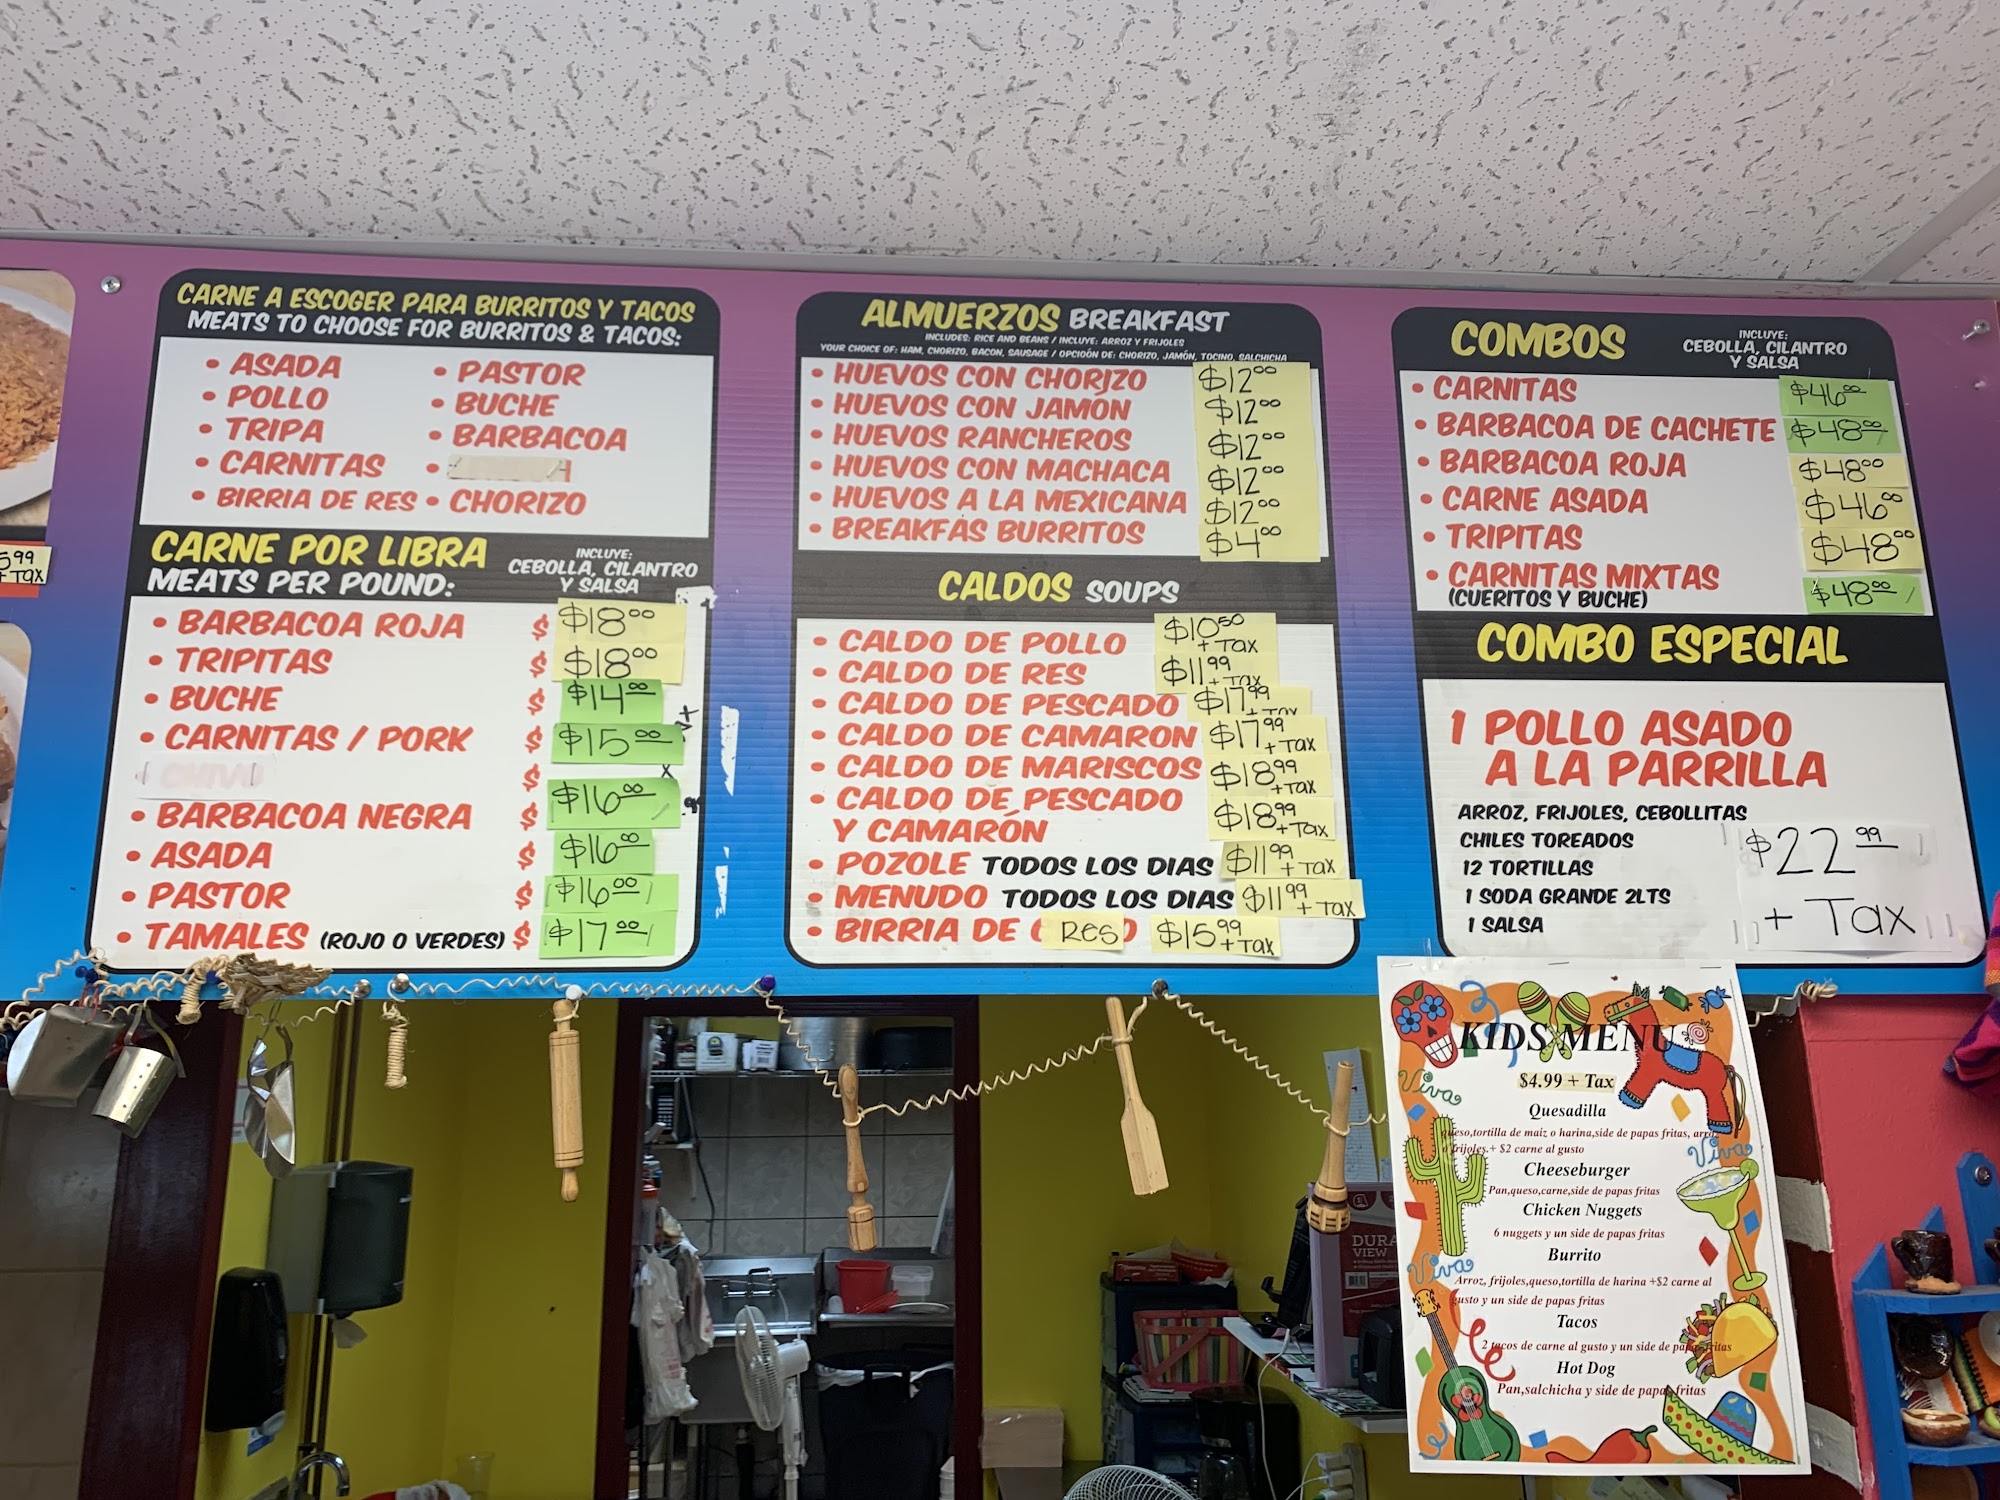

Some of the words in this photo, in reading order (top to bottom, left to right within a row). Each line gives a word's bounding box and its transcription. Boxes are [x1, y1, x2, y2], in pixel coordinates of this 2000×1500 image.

[177, 282, 260, 307] CARNE
[264, 287, 281, 308] A
[289, 287, 394, 312] ESCOGER
[402, 293, 466, 315] PARA
[475, 294, 591, 320] BURRITOS
[599, 299, 613, 319] Y
[621, 300, 696, 322] TACOS
[187, 310, 271, 332] MEATS
[276, 313, 307, 333] TO
[313, 314, 402, 337] CHOOSE
[407, 319, 453, 338] FOR
[459, 320, 572, 343] BURRITOS
[578, 325, 594, 342] &
[604, 325, 681, 346] TACOS:
[861, 299, 1061, 332] ALMUERZOS
[1069, 308, 1230, 333] BREAKFAST
[820, 344, 846, 352] YOUR
[848, 344, 881, 353] CHOICE
[883, 346, 898, 354] OF:
[901, 346, 924, 355] HAM,
[927, 347, 968, 357] CHORIZO,
[972, 348, 1005, 357] BACON,
[1008, 349, 1049, 357] SAUSAGE
[1101, 351, 1116, 359] DE:
[1118, 351, 1159, 361] CHORIZO,
[1163, 350, 1197, 362] JAMÓN,
[1238, 353, 1287, 362] SALCHICHA
[925, 333, 971, 342] INCLUDES:
[974, 334, 995, 343] RICE
[997, 335, 1017, 343] AND
[1019, 335, 1049, 344] BEANS
[1059, 336, 1098, 346] INCLUYE:
[1101, 337, 1132, 345] ARROZ
[1135, 338, 1141, 346] Y
[1143, 338, 1185, 347] FRIJOLES
[1451, 320, 1626, 360] COMBOS
[230, 352, 341, 378] ASADA
[458, 360, 585, 386] PASTOR
[833, 362, 949, 387] HUEVOS
[956, 365, 1017, 388] CON
[1025, 367, 1147, 392] CHORIZO
[227, 385, 328, 410] POLLO
[455, 392, 559, 416] BUCHE
[226, 417, 324, 442] TRIPA
[452, 423, 627, 451] BARBACOA
[833, 423, 949, 448] HUEVOS
[957, 426, 1132, 451] RANCHEROS
[1437, 411, 1594, 439] BARBACOA
[1604, 415, 1642, 440] DE
[1650, 416, 1777, 442] CACHETE
[220, 450, 386, 478] CARNITAS
[217, 487, 310, 509] BIRRIA
[320, 490, 356, 509] DE
[365, 490, 417, 511] RES
[449, 489, 586, 515] CHORIZO
[832, 485, 949, 510] HUEVOS
[957, 488, 977, 511] A
[989, 488, 1024, 511] LA
[1034, 489, 1187, 514] MEXICANA
[832, 516, 988, 542] BREAKFAS
[997, 520, 1145, 545] BURRITOS
[151, 530, 280, 563] CARNE
[289, 534, 369, 566] POR
[377, 534, 488, 568] LIBRA
[576, 548, 632, 560] INCLUYE:
[508, 558, 597, 577] CEBOLLA,
[604, 561, 698, 578] CILANTRO
[1449, 561, 1598, 588] CARNITAS
[1606, 563, 1720, 590] MIXTAS
[147, 568, 258, 593] MEATS
[268, 571, 330, 594] PER
[339, 573, 456, 597] POUND:
[561, 579, 574, 592] Y
[578, 577, 639, 594] SALSA
[938, 570, 1073, 602] CALDOS
[1085, 580, 1180, 604] SOUPS
[1449, 589, 1552, 608] (CUERITOS
[1560, 591, 1572, 607] Y
[1578, 590, 1648, 609] BUCHE)
[838, 629, 953, 653] CALDO
[965, 631, 1011, 653] DE
[1021, 632, 1127, 655] POLLO
[1476, 621, 1635, 664] COMBO
[1650, 624, 1848, 665] ESPECIAL
[176, 647, 332, 674] TRIPITAS
[377, 726, 474, 752] PORK
[1451, 710, 1467, 745] 1
[1485, 709, 1624, 746] POLLO
[1640, 710, 1792, 747] ASADO
[1608, 750, 1828, 788] PARRILLA
[156, 802, 347, 829] BARBACOA
[358, 803, 472, 830] NEGRA
[833, 818, 858, 843] Y
[867, 809, 1049, 843] CAMARÓN
[1458, 804, 1528, 822] ARROZ,
[1536, 805, 1628, 823] FRIJOLES,
[1635, 805, 1748, 821] CEBOLLITAS
[1460, 832, 1525, 848] CHILES
[1531, 832, 1634, 849] TOREADOS
[836, 851, 971, 876] POZOLE
[982, 856, 1077, 876] TODOS
[1085, 856, 1138, 876] LOS
[1147, 856, 1214, 876] DIAS
[1463, 859, 1482, 876] 12
[1489, 860, 1594, 877] TORTILLAS
[1479, 888, 1533, 905] SODA
[1539, 889, 1617, 905] GRANDE
[1625, 888, 1671, 905] 2LTS
[1765, 908, 1793, 931] +
[1804, 897, 1916, 936] Tax
[145, 922, 309, 950] TAMALES
[321, 931, 385, 950] (ROJO
[392, 932, 407, 949] O
[416, 931, 505, 950] VERDES)
[1458, 1022, 1548, 1052] KIDS
[1558, 1022, 1678, 1052] MENU
[1398, 1069, 1462, 1106] Viva
[1519, 1072, 1562, 1090] $4.99
[1568, 1075, 1580, 1088] +
[1584, 1073, 1614, 1090] Tax
[1529, 1103, 1607, 1120] Quesadilla
[1688, 1136, 1753, 1168] Viva
[1524, 1162, 1630, 1180] Cheeseburger
[1591, 1186, 1603, 1196] de
[1605, 1187, 1633, 1197] papas
[1634, 1186, 1660, 1197] fritas
[1523, 1203, 1580, 1217] Chicken
[1585, 1203, 1643, 1220] Nuggets
[1493, 1228, 1500, 1237] 6
[1502, 1229, 1542, 1240] nuggets
[1544, 1231, 1551, 1240] y
[1554, 1230, 1567, 1238] un
[1570, 1228, 1590, 1238] side
[1593, 1229, 1605, 1238] de
[1607, 1230, 1636, 1240] papas
[1637, 1229, 1665, 1240] fritas
[1353, 1248, 1387, 1257] VIEW
[1548, 1248, 1601, 1262] Burrito
[1407, 1253, 1474, 1285] Viva
[1557, 1314, 1598, 1329] Tacos
[1556, 1361, 1583, 1375] Hot
[1587, 1361, 1616, 1378] Dog
